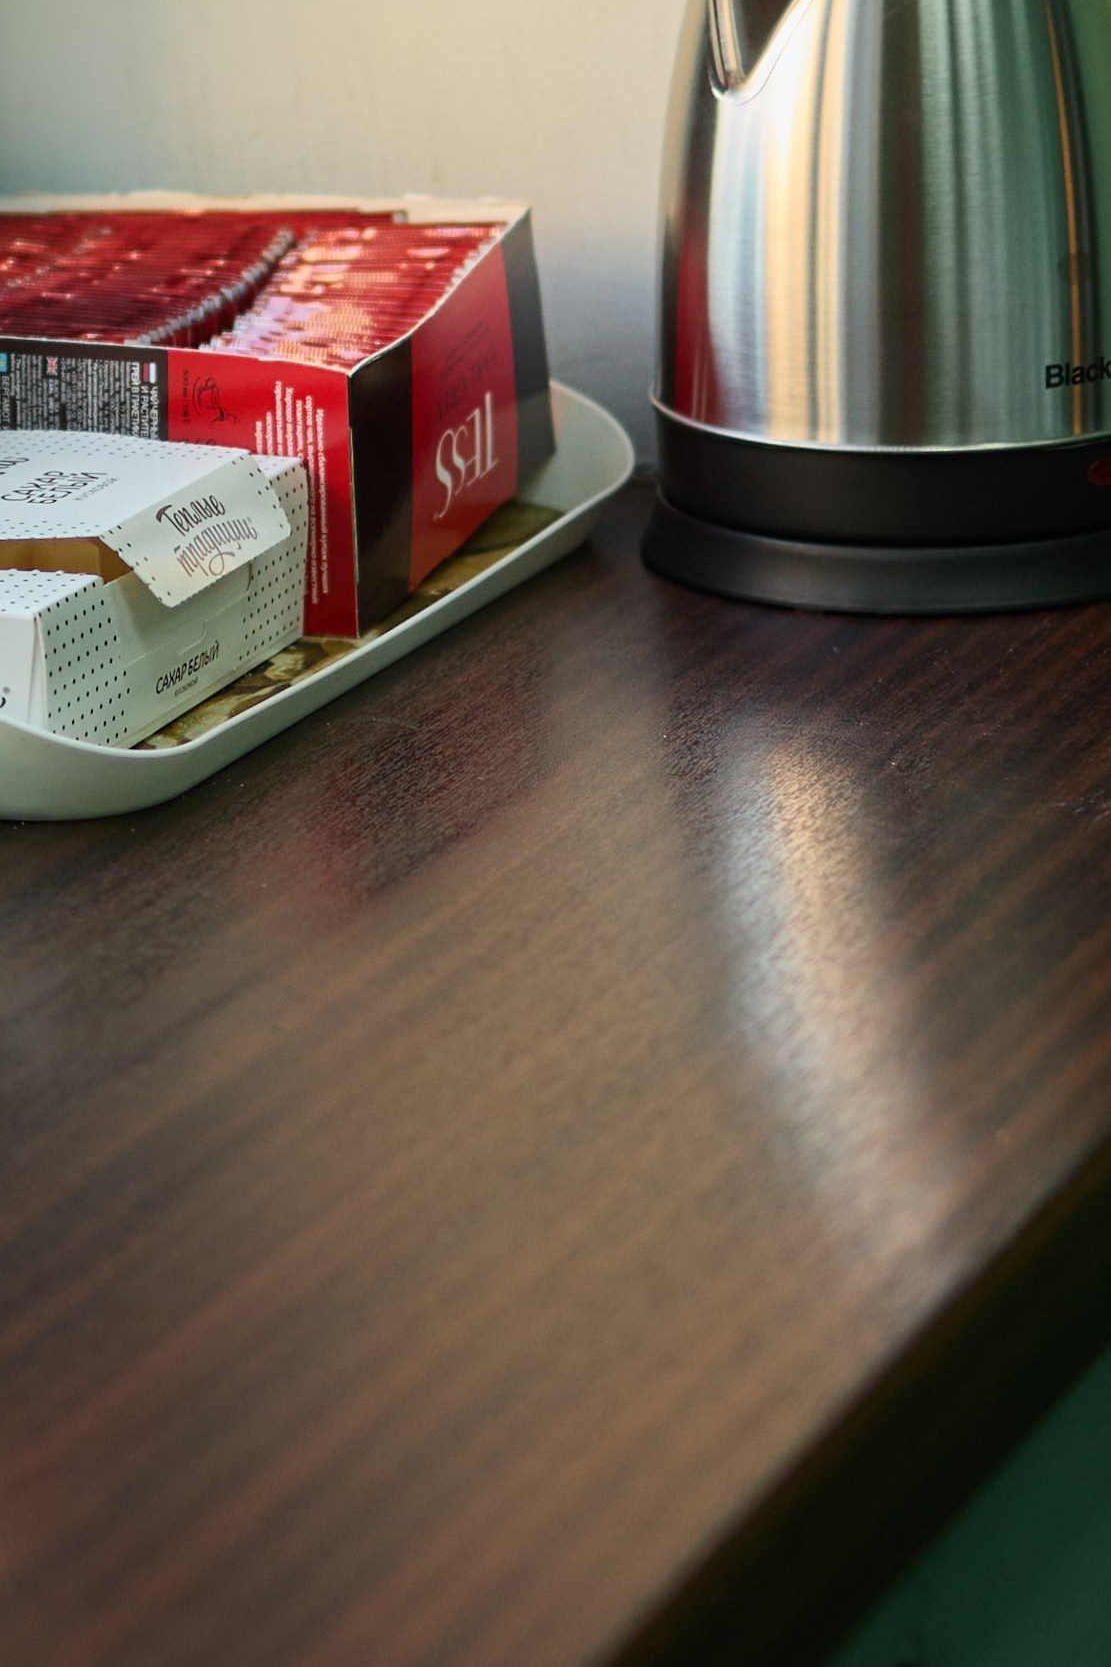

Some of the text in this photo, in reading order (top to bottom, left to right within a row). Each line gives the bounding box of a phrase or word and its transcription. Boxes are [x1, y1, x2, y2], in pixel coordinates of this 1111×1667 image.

[1046, 355, 1111, 389] Black
[1, 471, 69, 501] САХАР
[27, 472, 107, 504] БЕЛЫЙ
[156, 495, 226, 536] Теплые
[174, 517, 258, 577] традиции
[156, 640, 219, 694] САХАР БЕЛЫЙ
